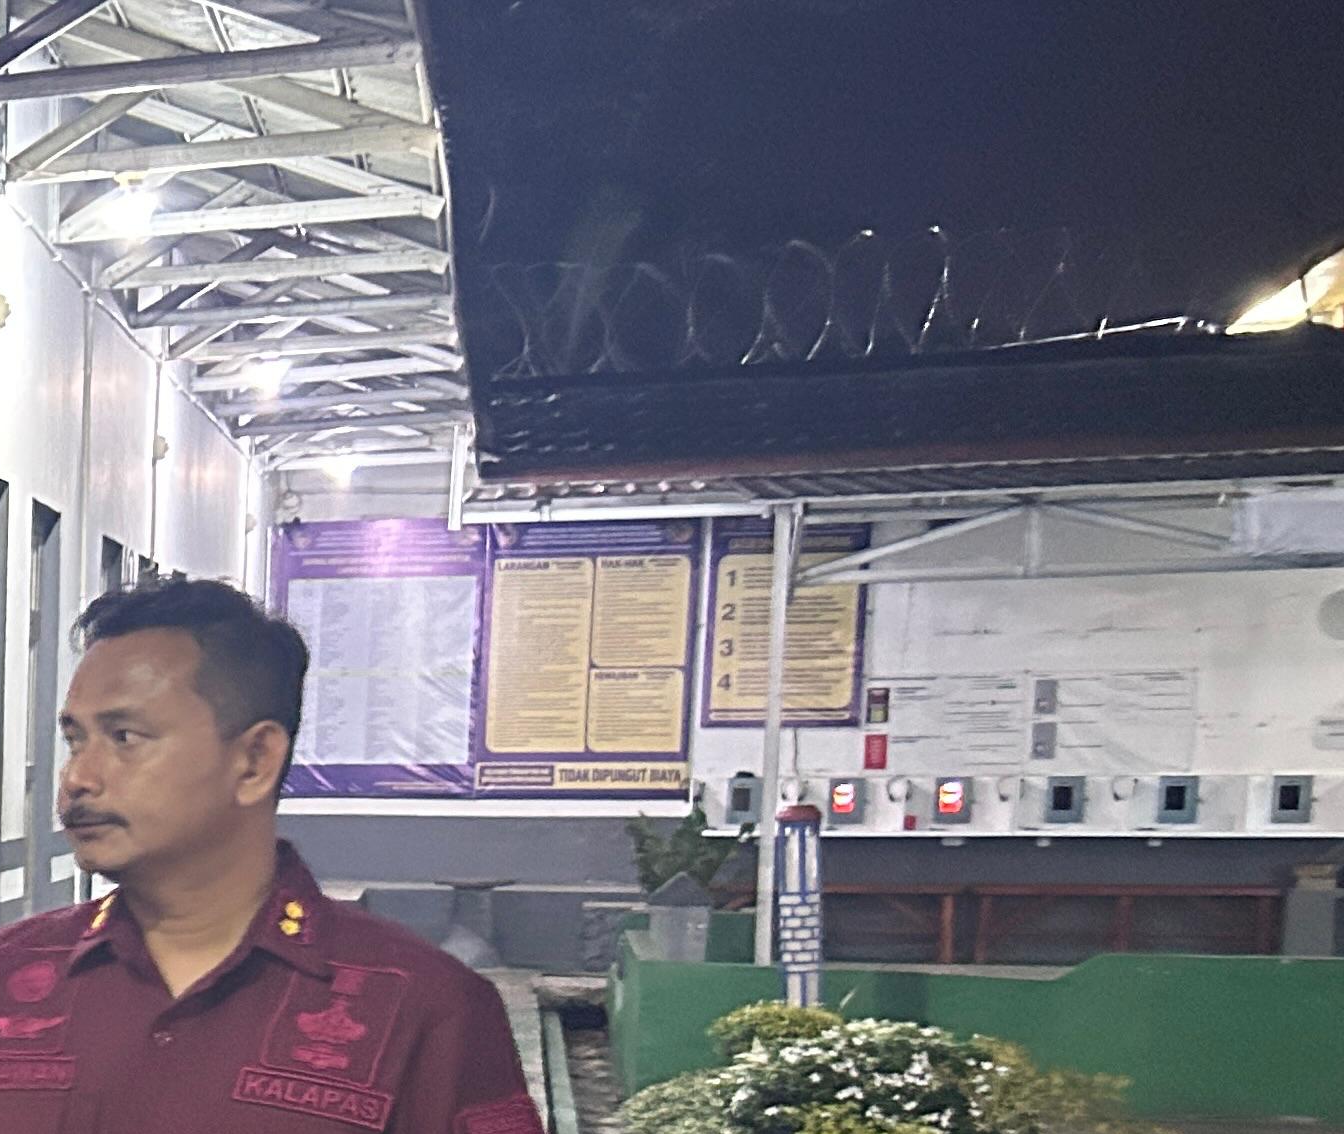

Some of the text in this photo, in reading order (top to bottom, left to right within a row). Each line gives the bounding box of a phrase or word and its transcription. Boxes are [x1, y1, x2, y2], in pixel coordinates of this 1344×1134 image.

[726, 570, 736, 587] 1
[721, 603, 736, 620] 2
[719, 639, 734, 657] 3
[717, 673, 731, 691] 4
[243, 1075, 380, 1120] KALAPAS
